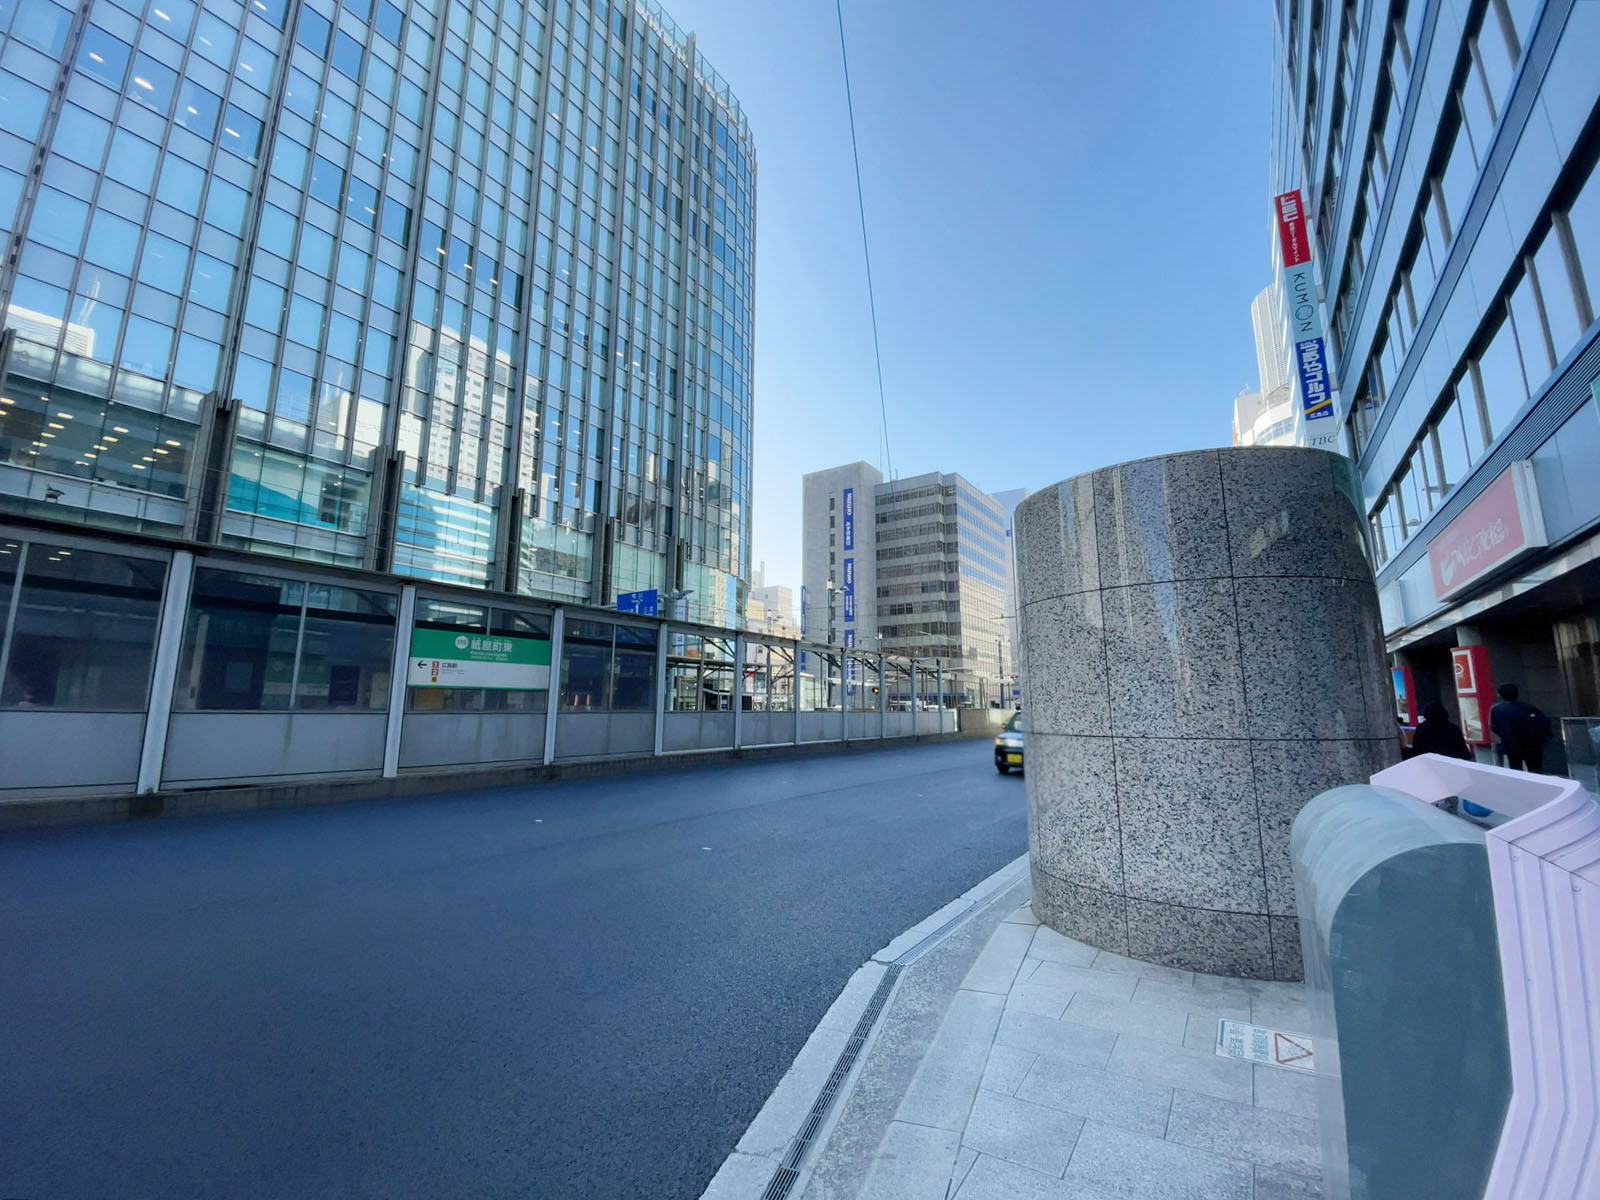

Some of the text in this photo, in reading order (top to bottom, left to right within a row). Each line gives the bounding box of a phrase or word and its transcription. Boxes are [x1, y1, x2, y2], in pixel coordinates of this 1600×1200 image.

[1293, 272, 1314, 333] KUMON
[1311, 434, 1336, 447] TBC
[470, 638, 513, 653] 紙屋町東
